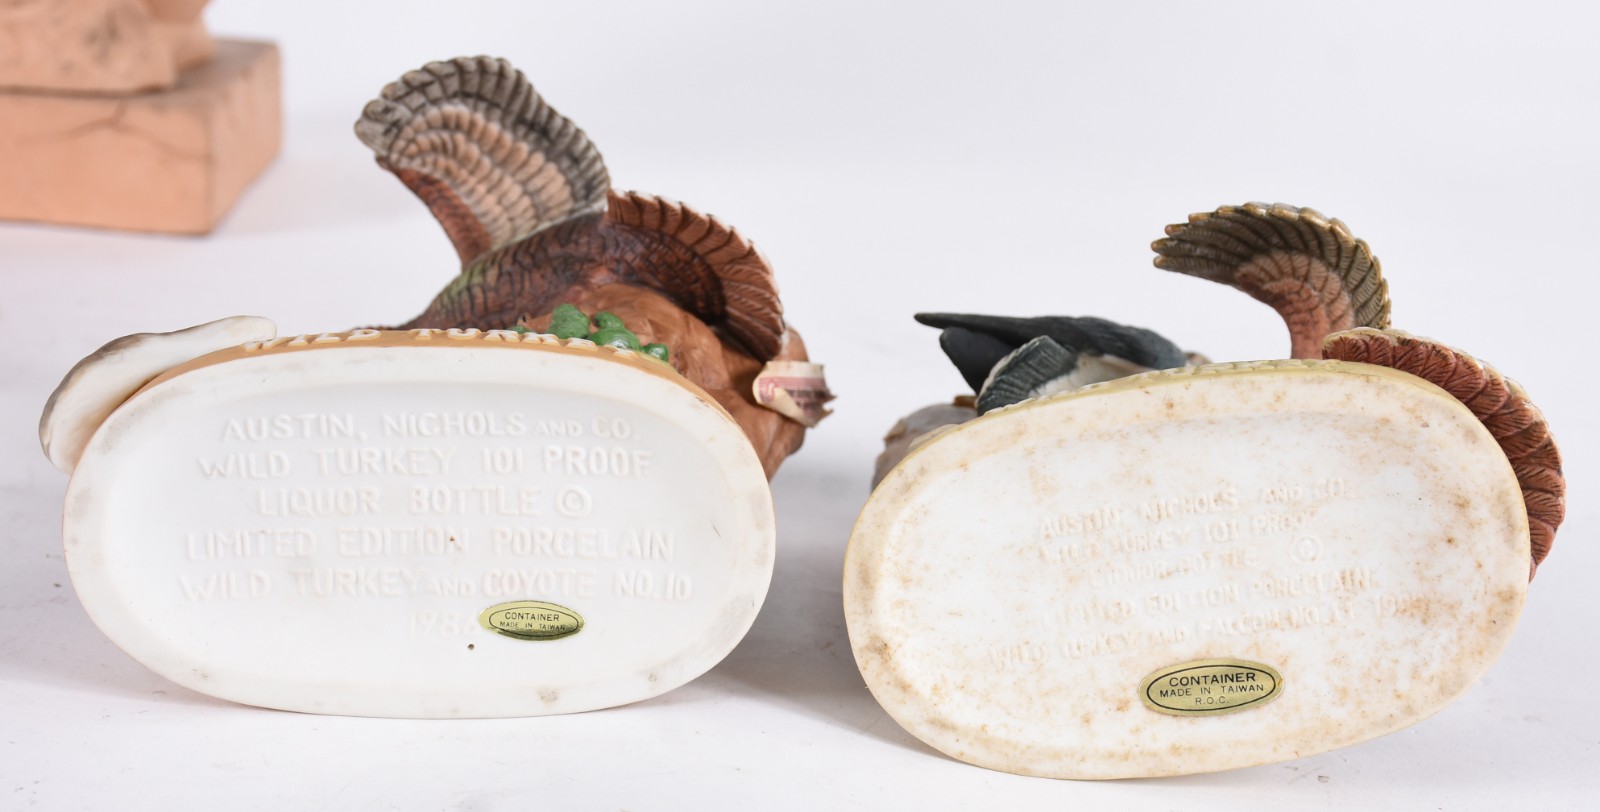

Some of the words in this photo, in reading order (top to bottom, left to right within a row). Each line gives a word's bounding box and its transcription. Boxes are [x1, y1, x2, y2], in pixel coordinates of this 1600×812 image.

[408, 328, 640, 358] TURKEY
[380, 411, 528, 438] NICHOLS
[535, 419, 584, 438] AND
[591, 415, 642, 441] CO.
[197, 450, 292, 480] WILD
[313, 446, 455, 477] TURKEY
[544, 444, 653, 478] PROOF
[257, 486, 381, 518] LIQUOR
[408, 483, 541, 516] BOTTLE
[1140, 488, 1239, 521] NICHOLS
[185, 527, 317, 561] LIMITED
[336, 526, 470, 557] EDITION
[491, 527, 675, 563] PORCELAIN
[178, 569, 272, 601] WILD
[289, 566, 425, 598] TURKEY
[426, 576, 477, 597] AND
[483, 567, 598, 599] COYOTE
[499, 620, 520, 629] MADE
[538, 623, 566, 632] TAIWAN
[504, 611, 560, 622] CONTAINER
[1159, 687, 1192, 698] MADE
[1200, 687, 1211, 696] IN
[1222, 684, 1264, 694] TAIWAN
[1169, 672, 1256, 687] CONTAINER
[1195, 696, 1230, 705] R.O.C.
